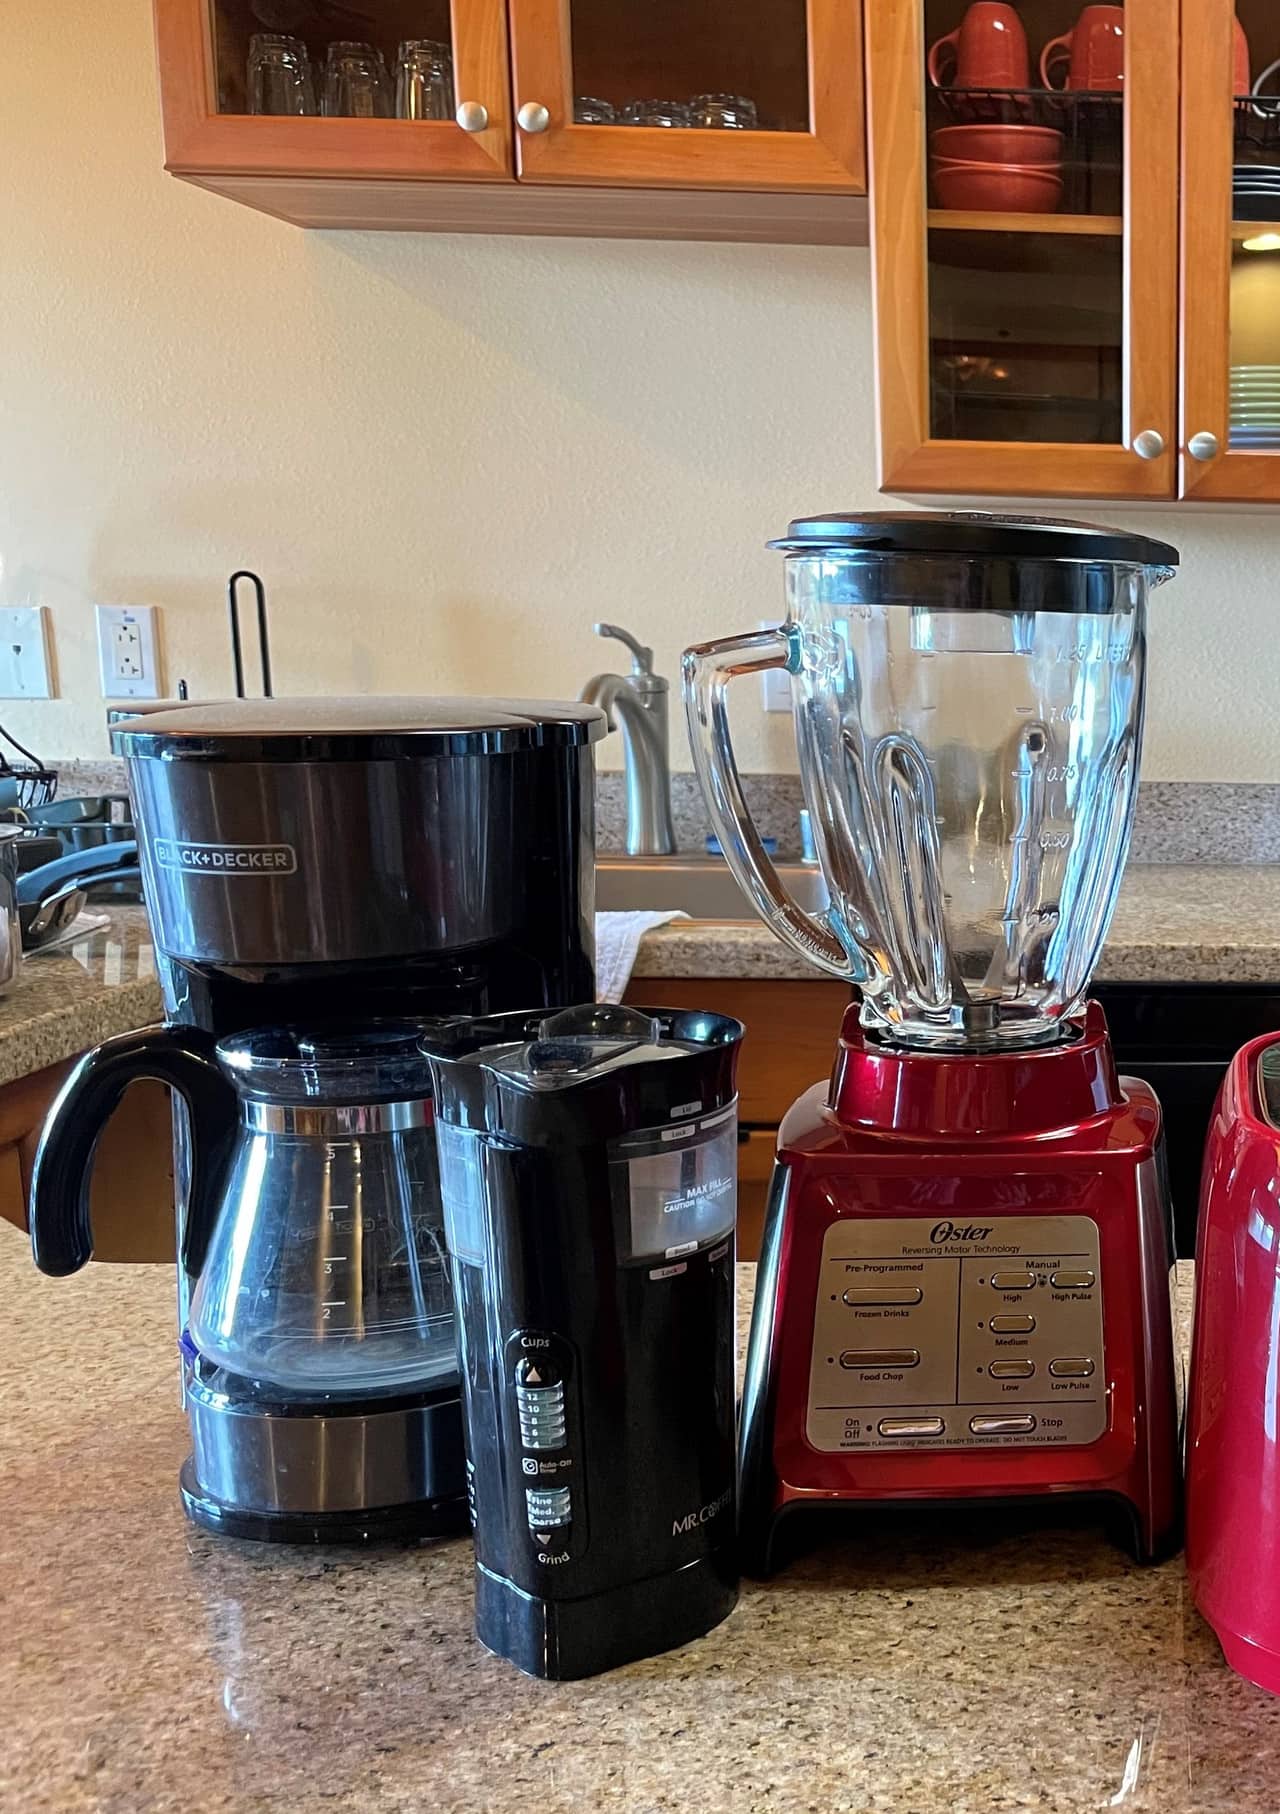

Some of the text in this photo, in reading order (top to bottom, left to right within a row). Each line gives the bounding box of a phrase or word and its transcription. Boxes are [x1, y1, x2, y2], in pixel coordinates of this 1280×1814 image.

[1047, 765, 1076, 782] 0.75
[1040, 832, 1070, 848] 0.50
[157, 846, 288, 868] BLACK+DECKER
[327, 1149, 335, 1160] 5
[687, 1183, 708, 1199] MAX
[709, 1178, 722, 1191] FILL
[664, 1199, 696, 1213] CAUTION
[930, 1221, 993, 1244] Oster
[902, 1244, 1021, 1256] Reversing Motor Technology
[324, 1263, 332, 1274] 3
[845, 1263, 924, 1274] Pre-Programmed
[1025, 1260, 1061, 1270] Manual
[1003, 1293, 1022, 1303] High
[1051, 1291, 1092, 1302] High Pulse
[322, 1309, 331, 1319] 2
[855, 1309, 910, 1319] Frozen Drinks
[521, 1337, 550, 1349] Cups
[995, 1338, 1029, 1347] Medium
[860, 1371, 904, 1383] Food Chop
[1001, 1383, 1019, 1392] Low
[1051, 1381, 1090, 1391] Low Pulse
[527, 1393, 538, 1401] 12
[528, 1405, 540, 1413] 10
[845, 1417, 860, 1428] On
[1041, 1416, 1063, 1428] Stop
[532, 1429, 538, 1437] 6
[844, 1429, 860, 1440] Off
[539, 1459, 572, 1469] Auto-Off
[538, 1552, 571, 1566] Grind
